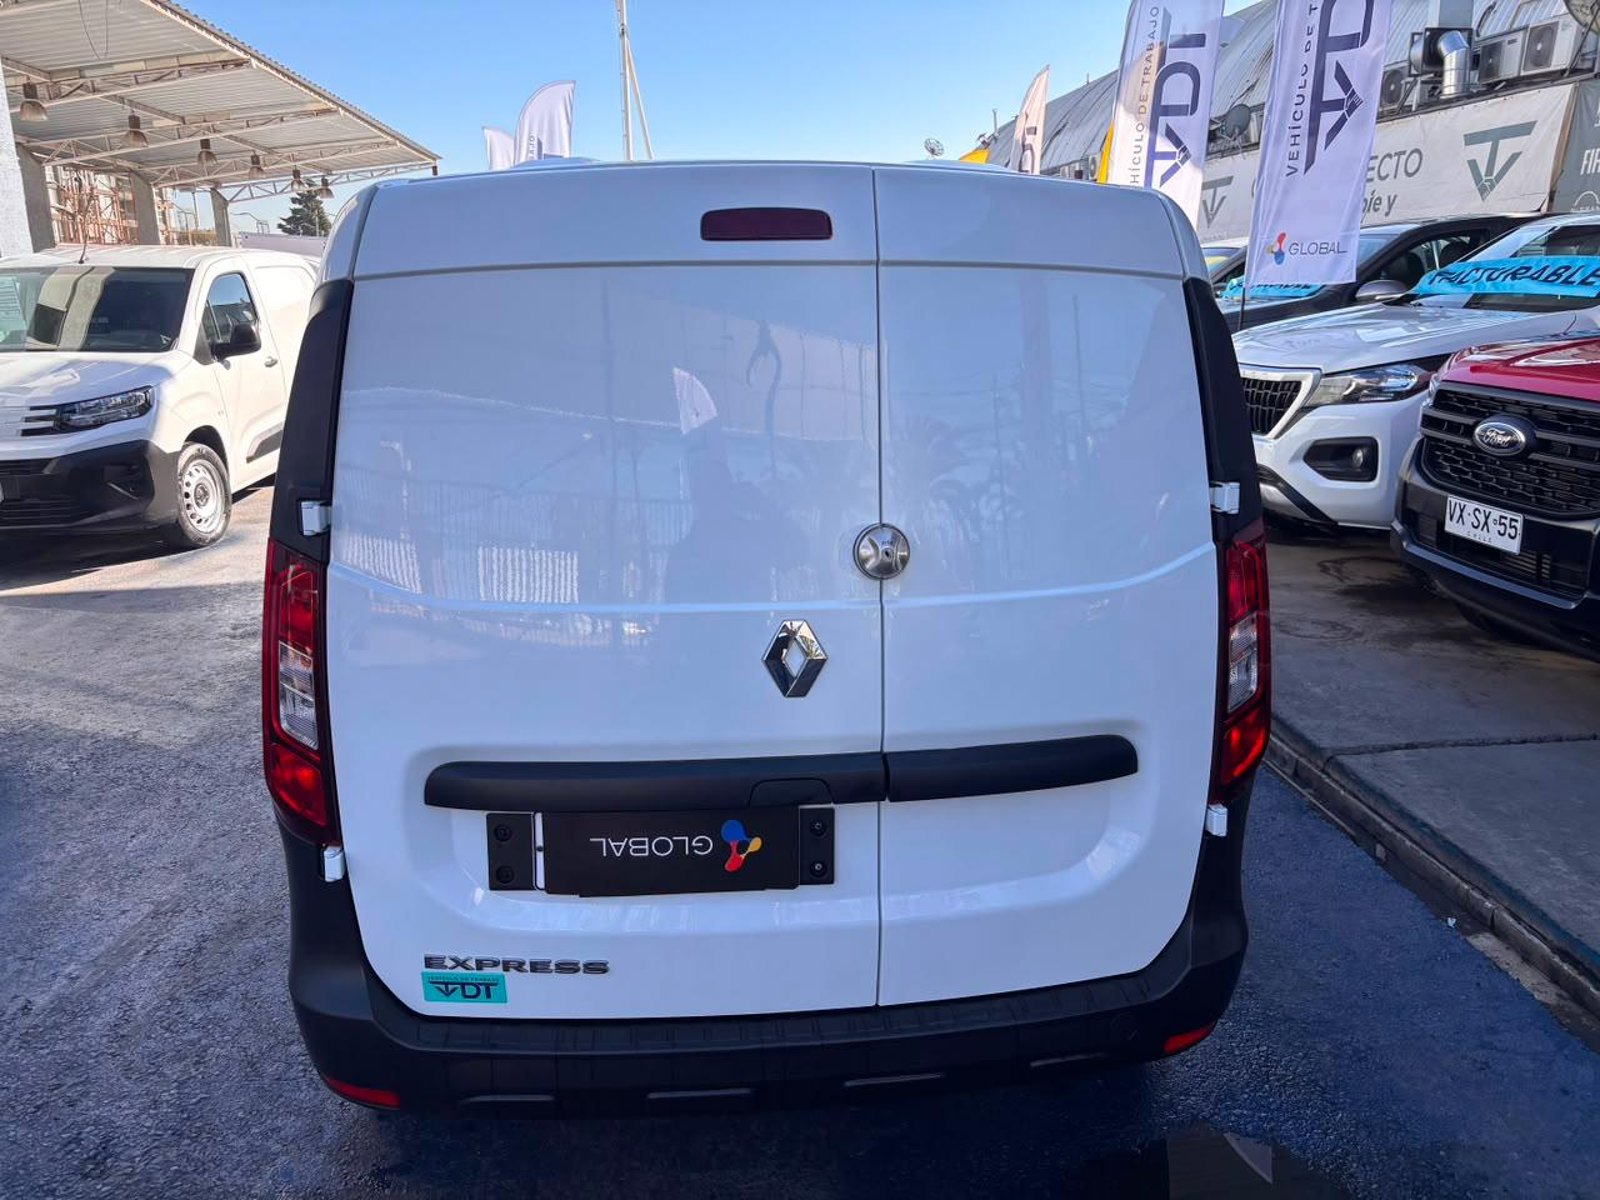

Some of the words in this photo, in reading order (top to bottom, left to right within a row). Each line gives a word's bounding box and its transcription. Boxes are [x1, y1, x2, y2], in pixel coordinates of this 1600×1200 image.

[1141, 5, 1160, 89] TRABAJO
[1138, 90, 1148, 116] DE
[1288, 241, 1348, 256] GLOBAL
[1483, 427, 1511, 448] Ford
[589, 835, 713, 857] GLOBAL
[424, 953, 609, 975] EXPRESS
